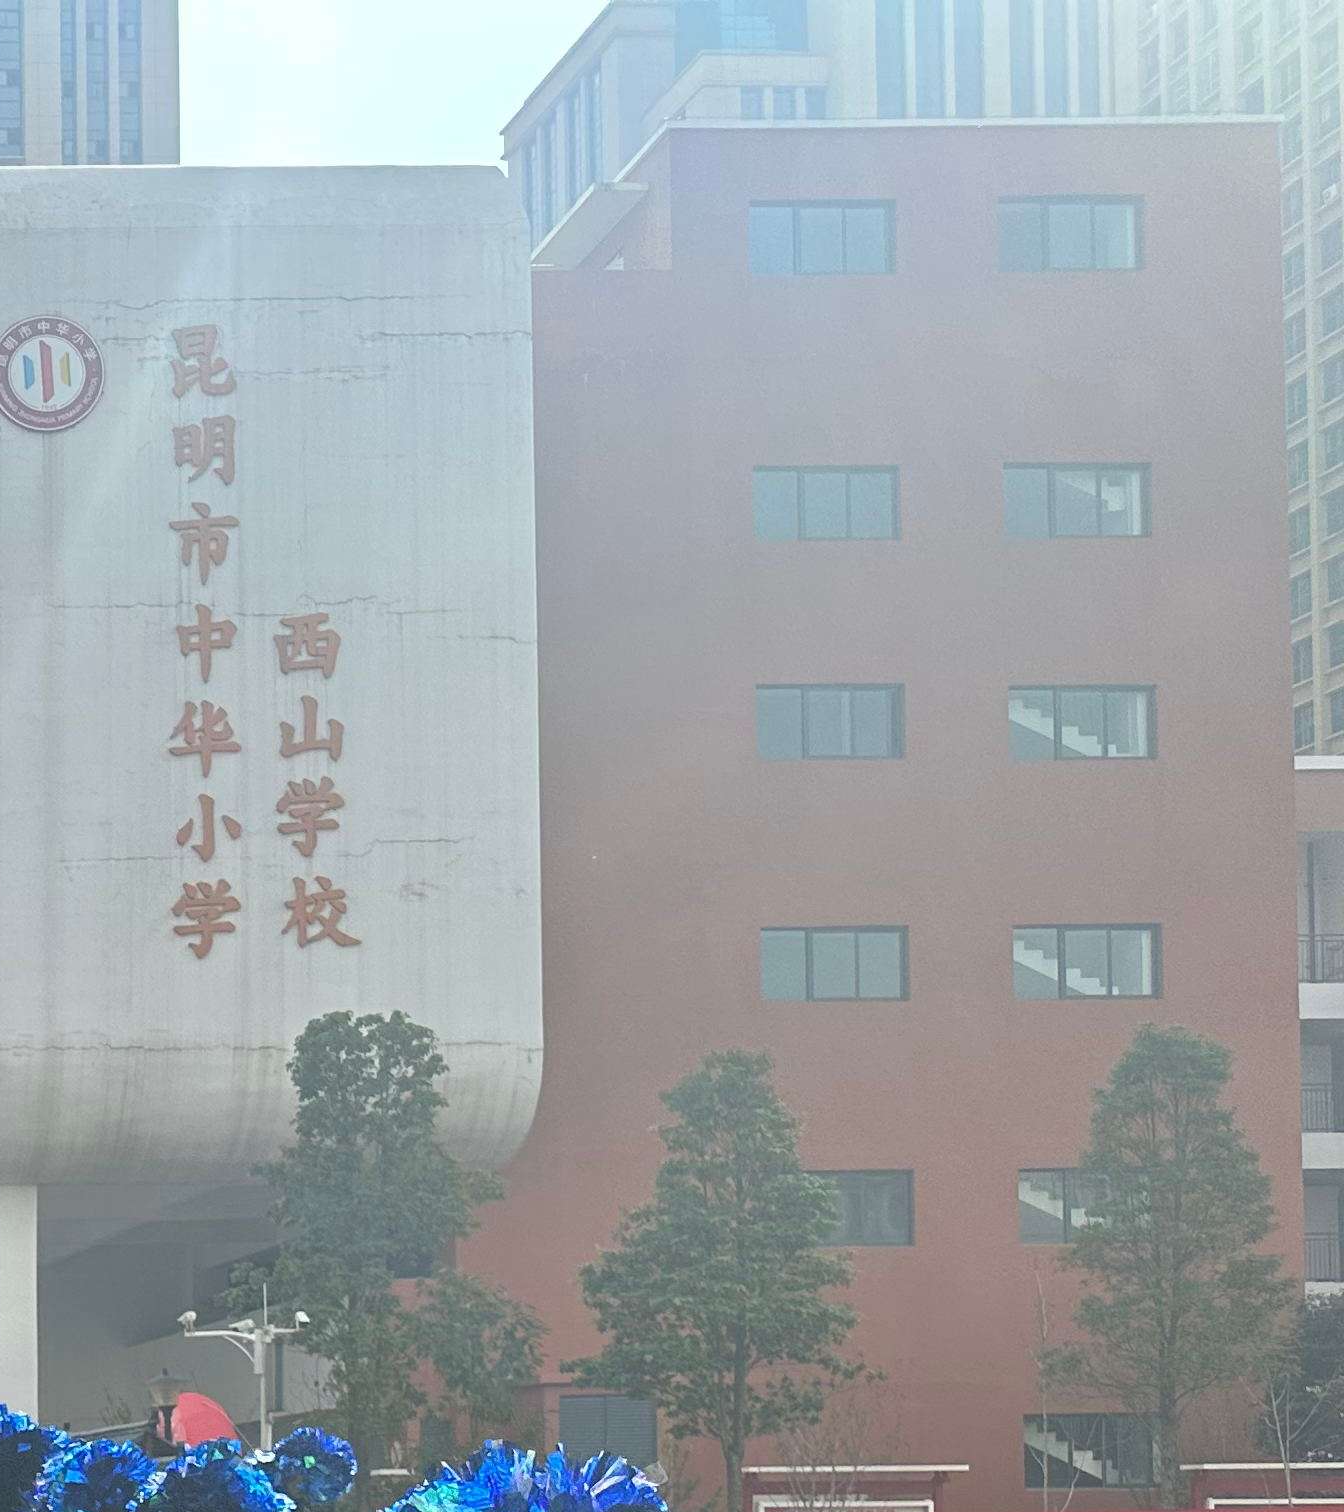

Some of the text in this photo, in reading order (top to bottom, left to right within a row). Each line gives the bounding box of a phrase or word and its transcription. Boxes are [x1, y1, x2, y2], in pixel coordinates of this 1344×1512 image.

[169, 323, 242, 960] 昆明市中华小学
[273, 612, 362, 948] 西山学校
